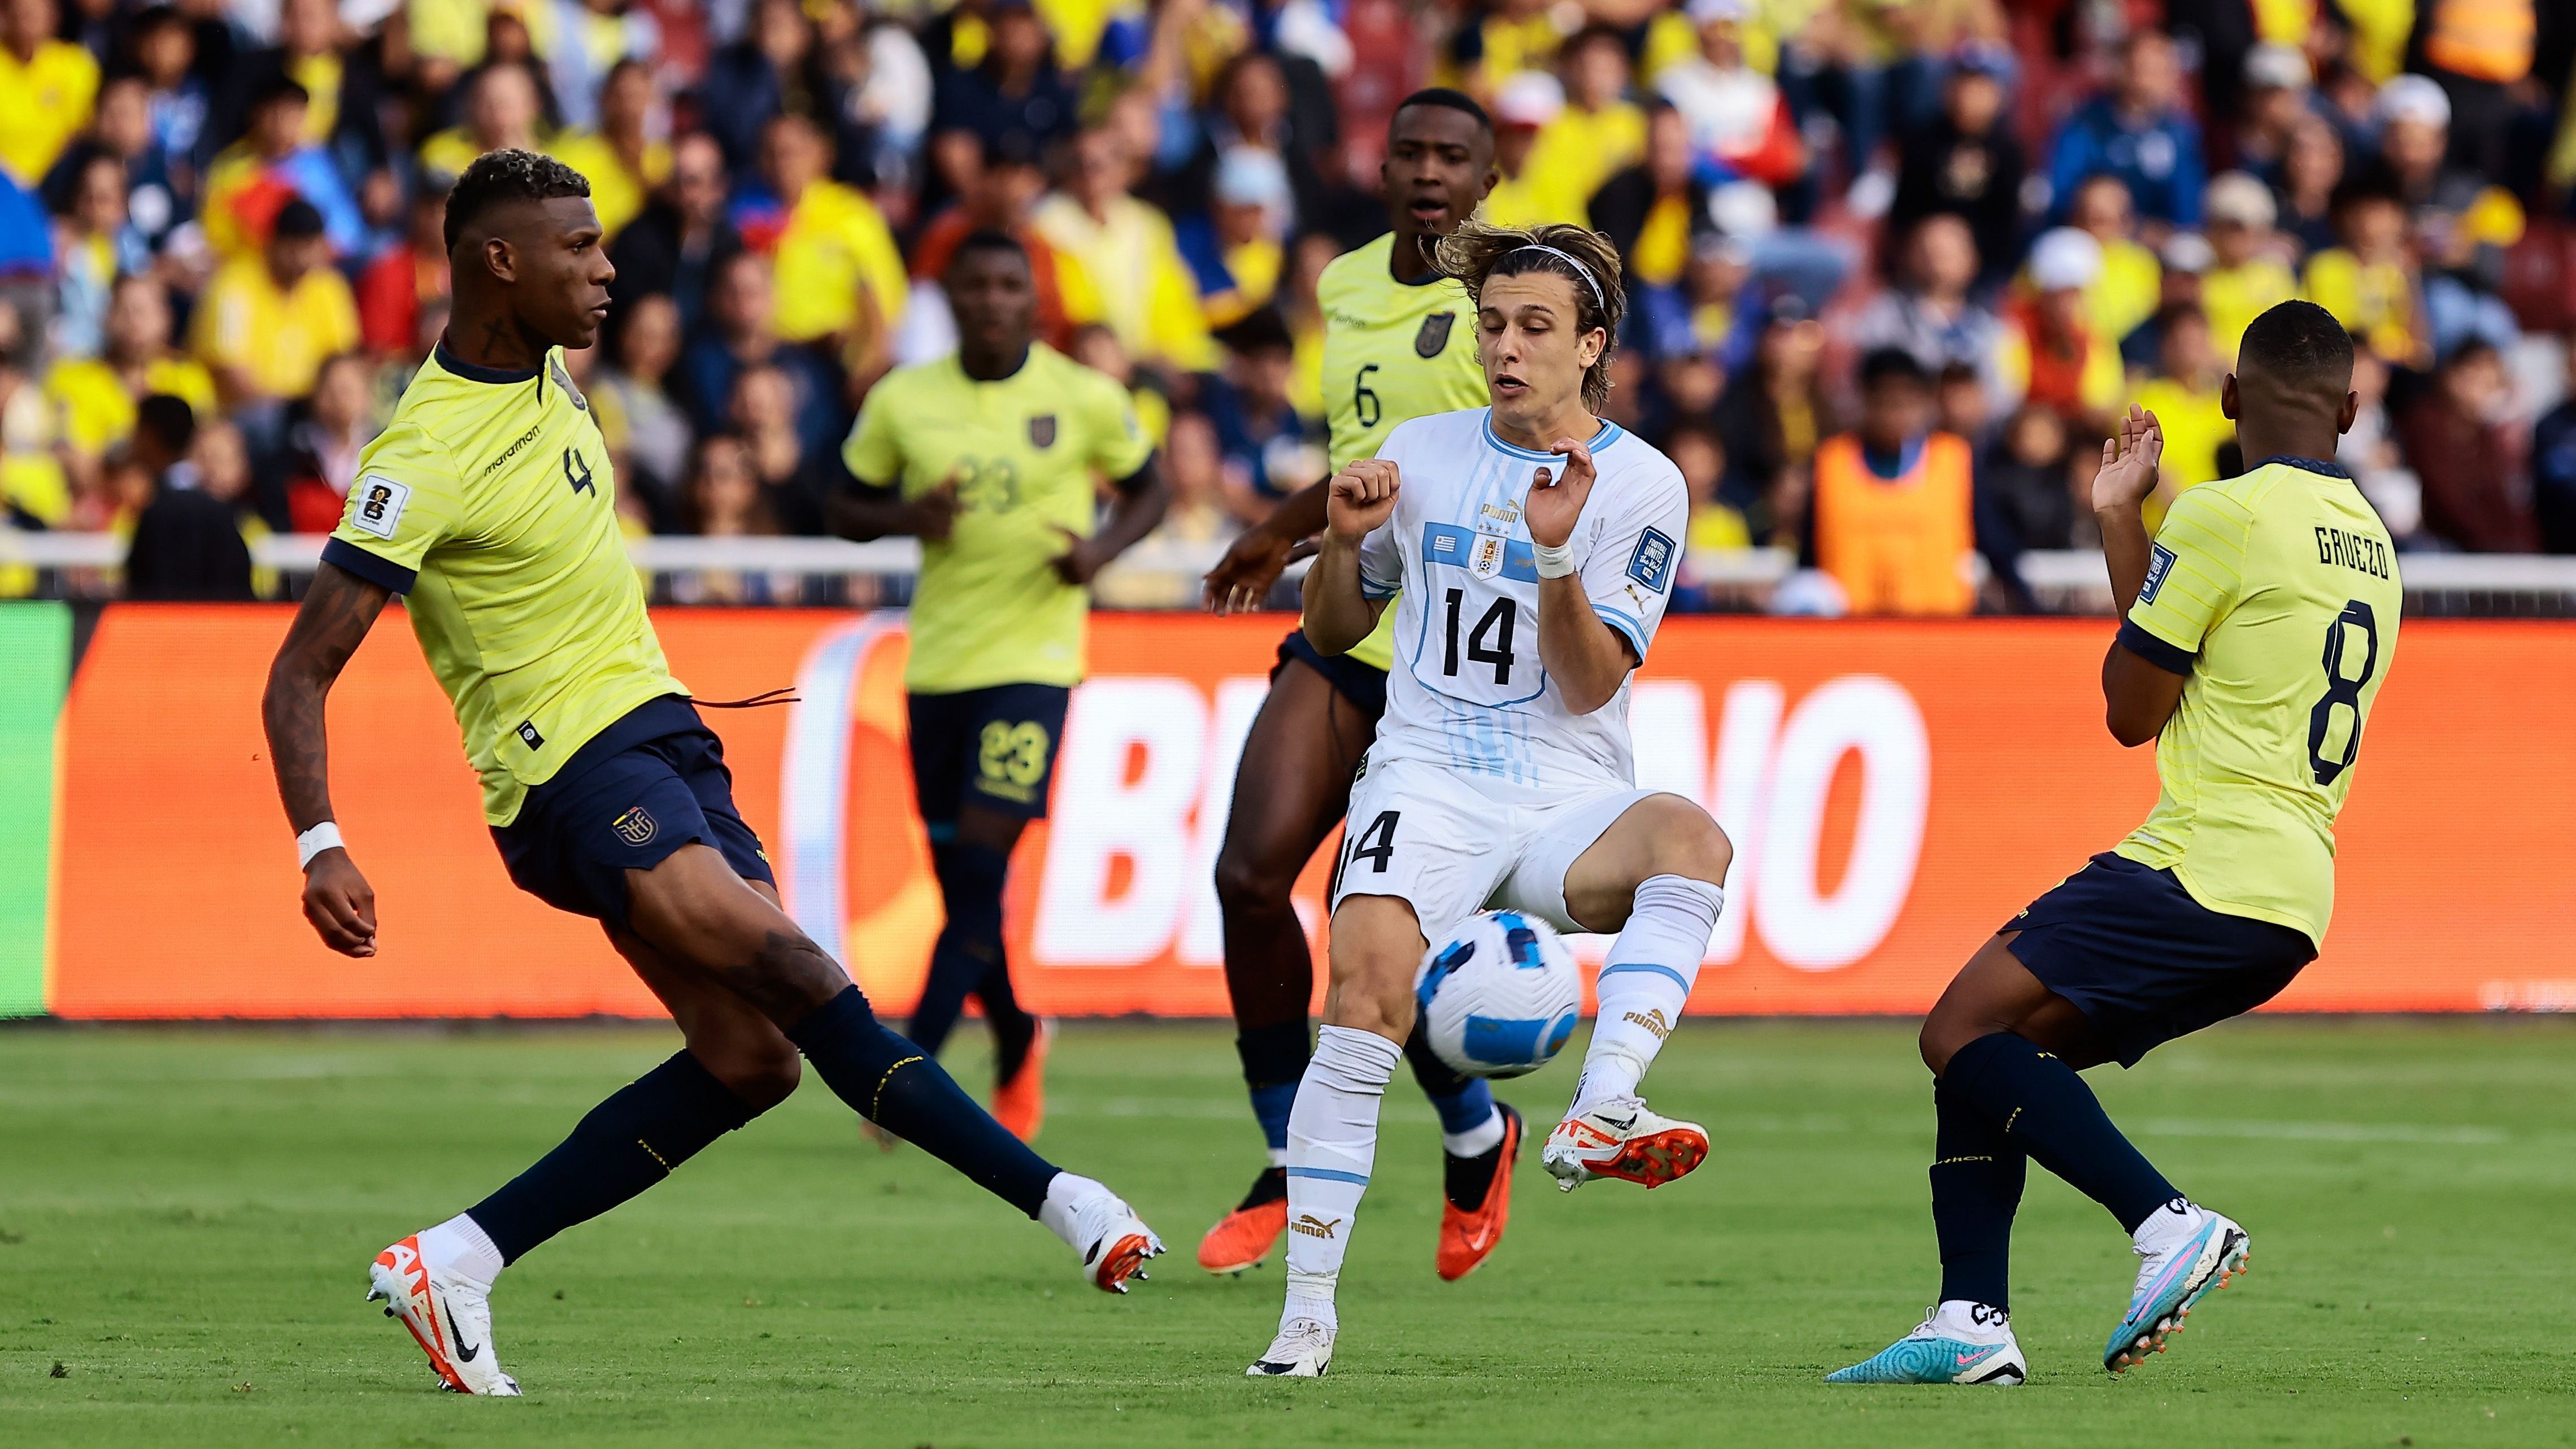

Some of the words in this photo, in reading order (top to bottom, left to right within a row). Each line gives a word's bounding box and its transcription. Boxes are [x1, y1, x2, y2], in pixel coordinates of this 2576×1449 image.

[1355, 364, 1380, 428] 6
[484, 425, 541, 477] marathon
[563, 445, 596, 499] 4
[954, 454, 1019, 516] 23
[1480, 503, 1518, 523] PUMA
[1644, 544, 1665, 564] UNITES
[1648, 537, 1668, 555] FOOTBALL
[2314, 526, 2389, 581] GRUEZO
[1443, 588, 1517, 685] 14
[2307, 599, 2378, 786] 8
[978, 719, 1050, 787] 23
[1622, 1011, 1663, 1041] PUMA
